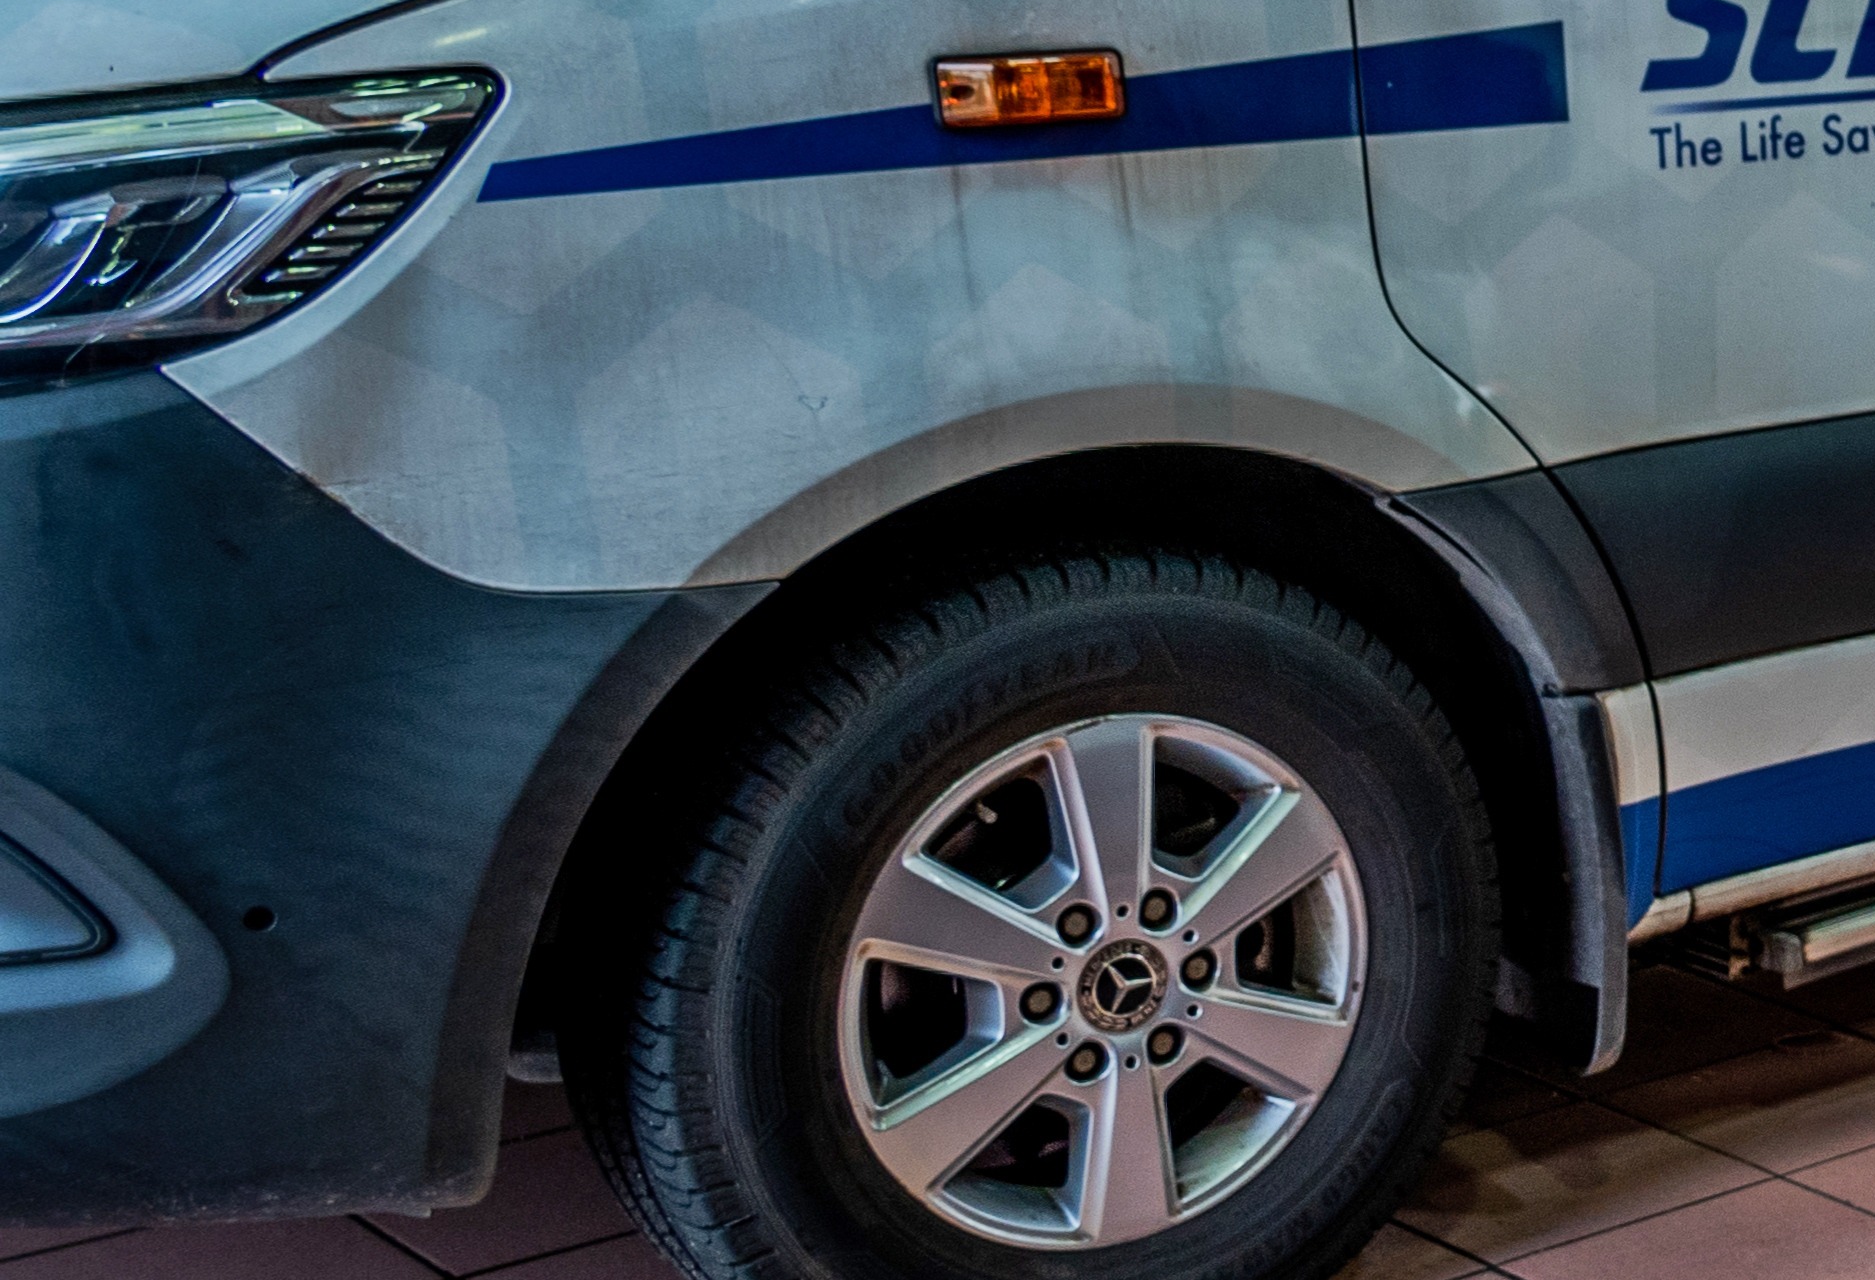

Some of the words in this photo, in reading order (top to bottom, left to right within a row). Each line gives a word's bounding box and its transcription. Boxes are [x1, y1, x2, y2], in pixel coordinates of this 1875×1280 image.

[1650, 122, 1723, 170] The
[1741, 115, 1806, 163] Life
[840, 644, 1120, 830] GOODYEAR
